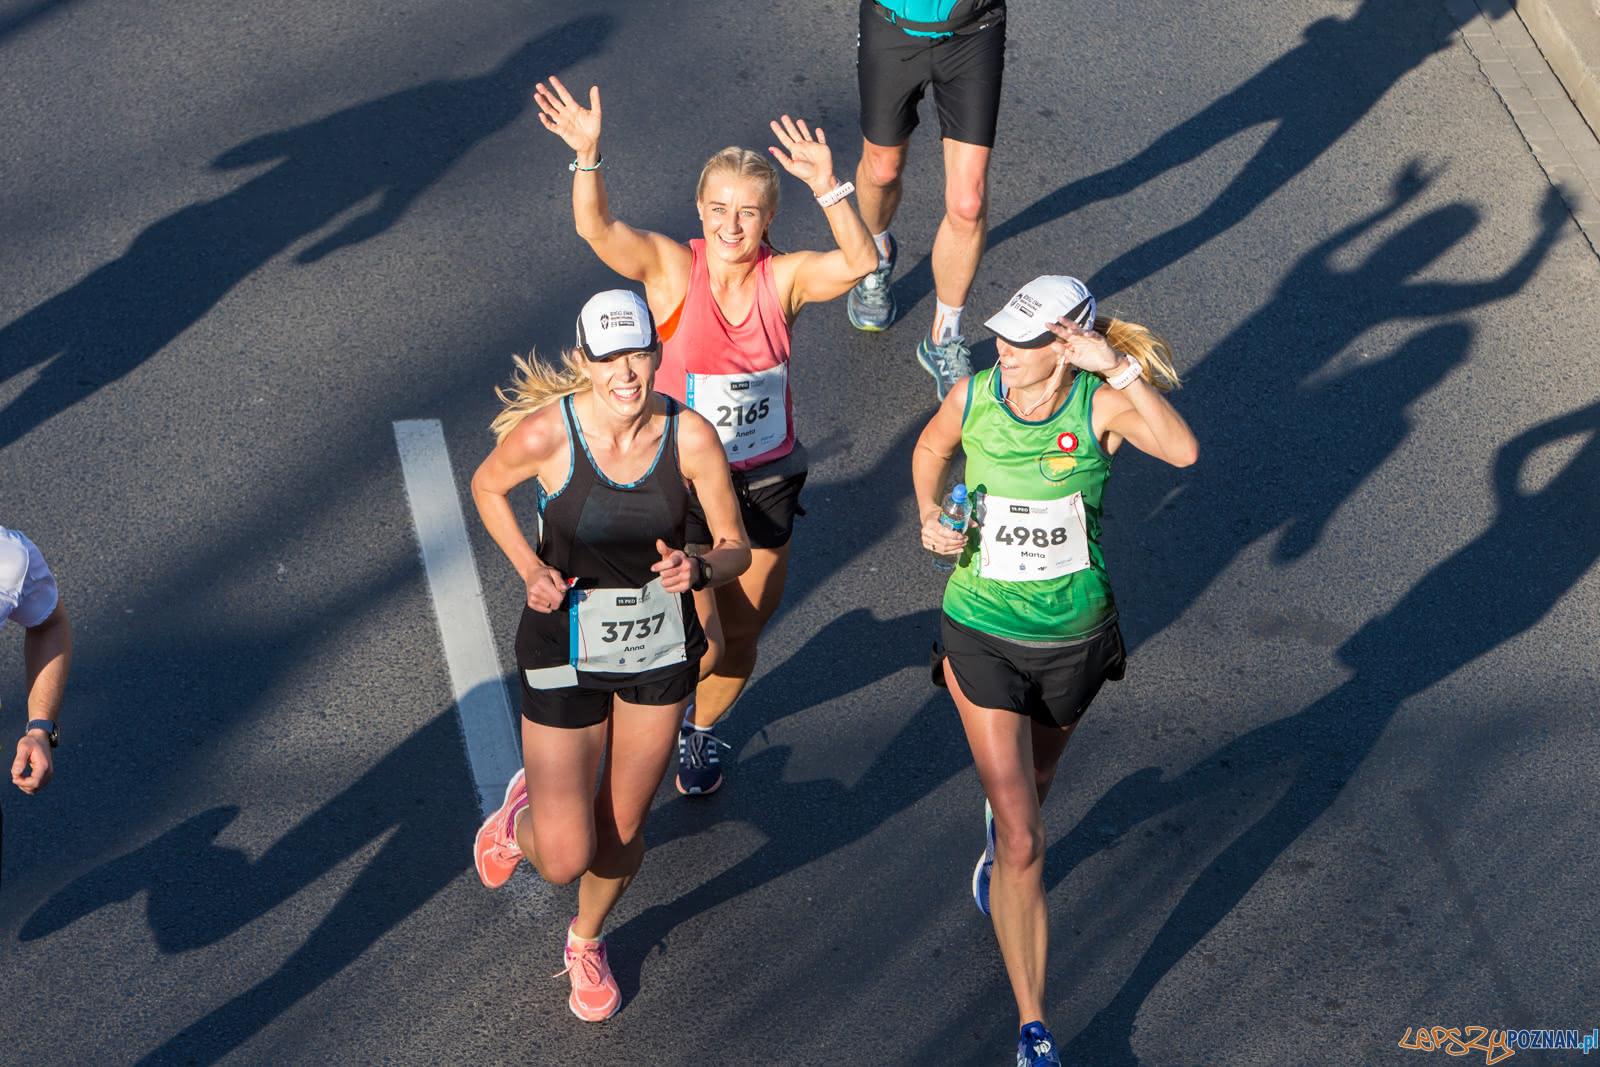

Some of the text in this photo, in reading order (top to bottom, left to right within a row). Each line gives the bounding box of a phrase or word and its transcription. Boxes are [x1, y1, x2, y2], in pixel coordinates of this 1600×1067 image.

[717, 397, 769, 426] 2165
[995, 525, 1068, 548] 4988
[1020, 551, 1046, 559] Marta
[601, 612, 666, 643] 3737
[624, 644, 646, 652] Anna
